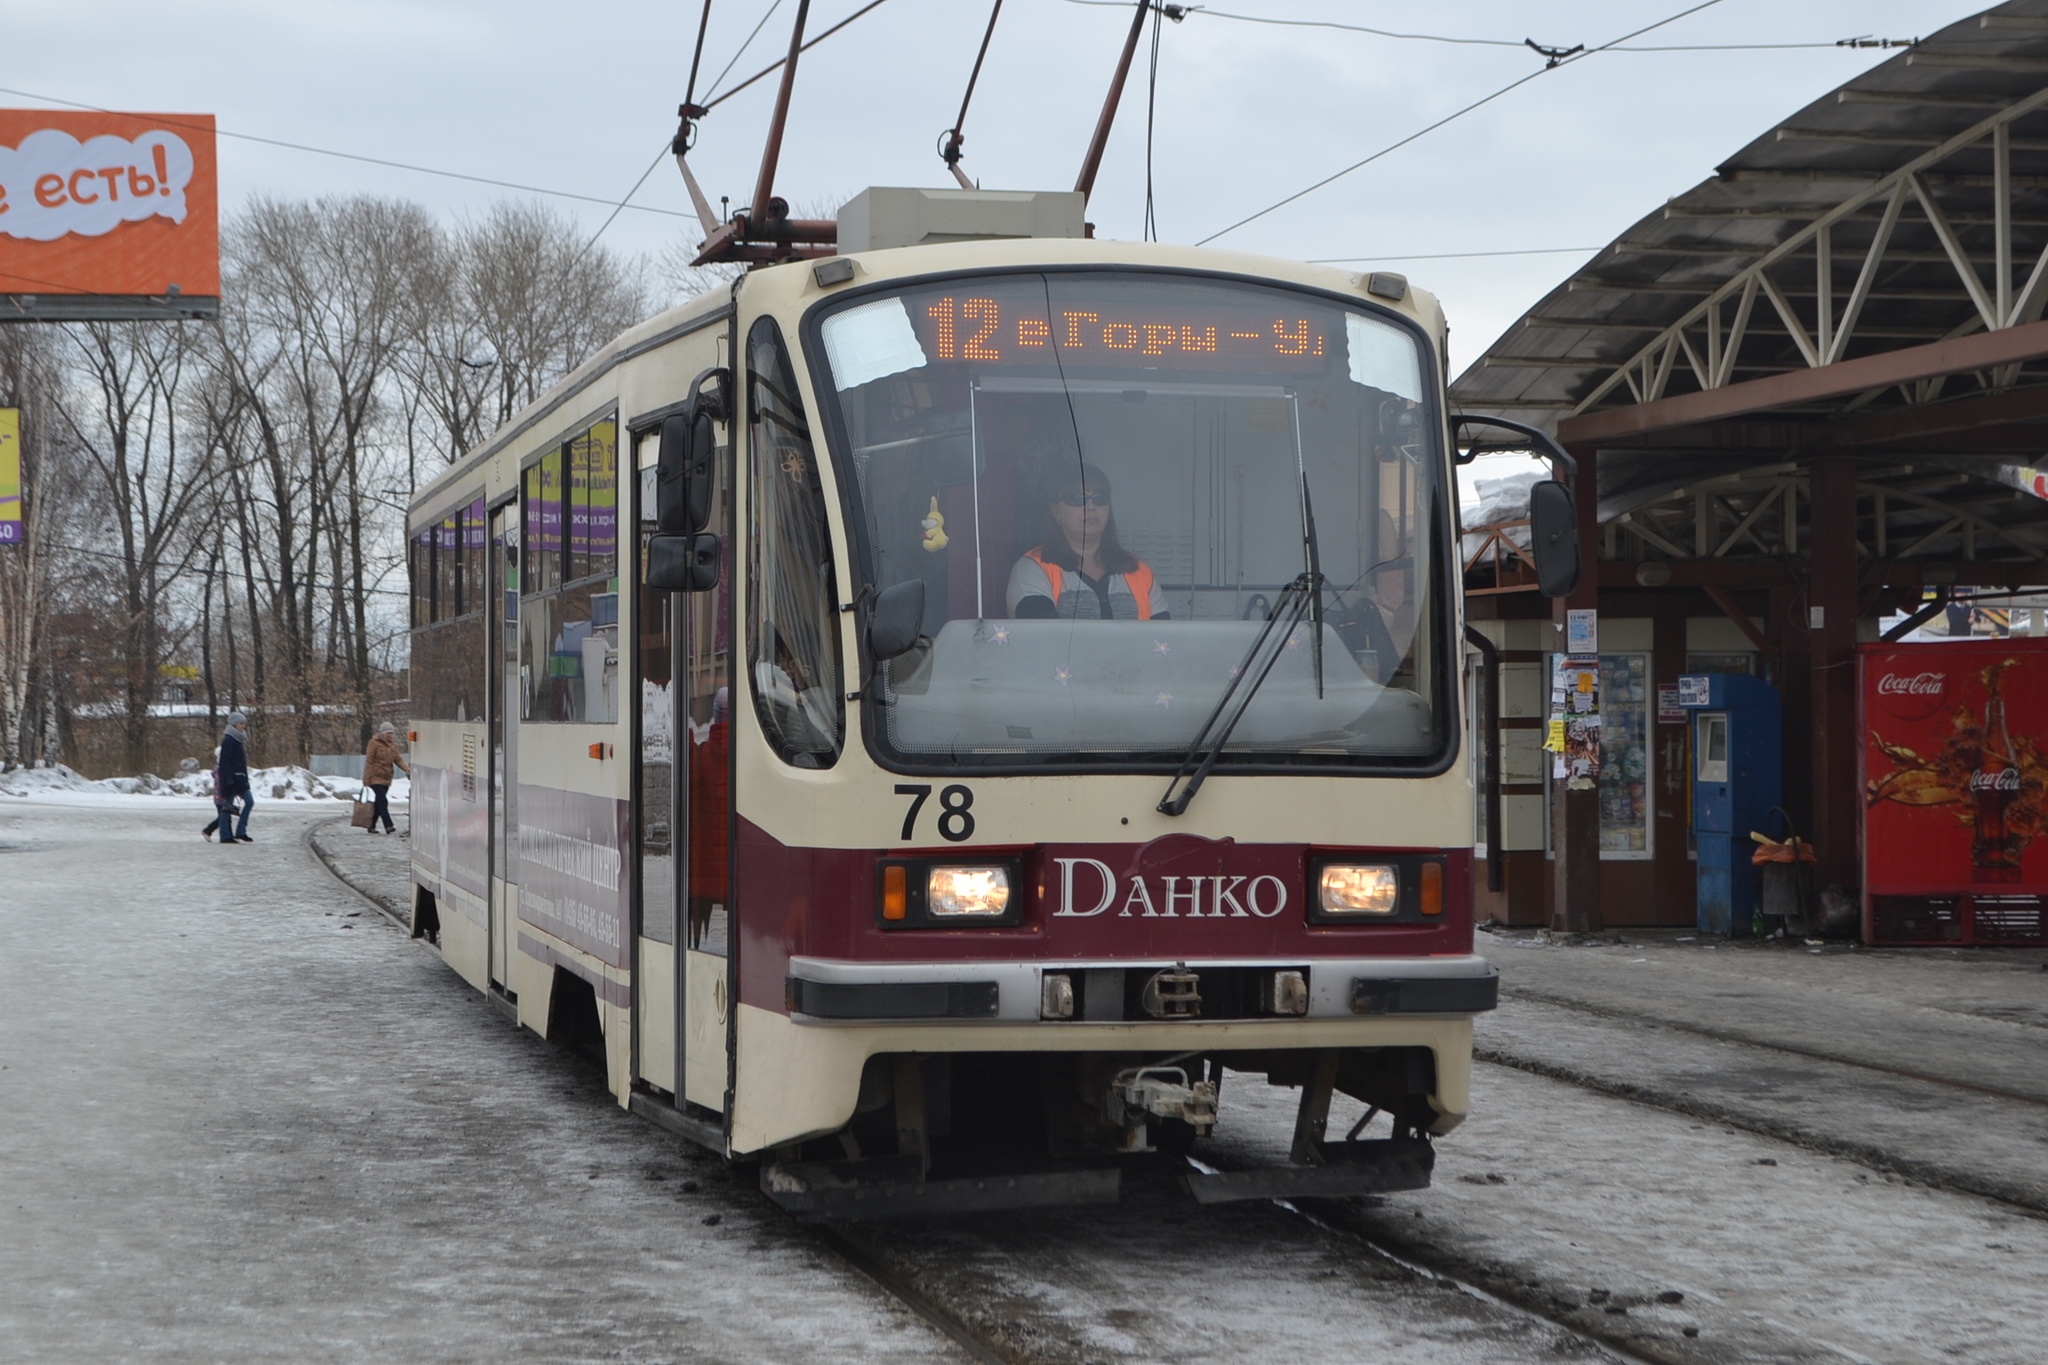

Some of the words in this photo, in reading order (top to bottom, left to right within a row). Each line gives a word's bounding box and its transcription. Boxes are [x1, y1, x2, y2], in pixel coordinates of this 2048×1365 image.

[34, 143, 171, 209] есть!
[928, 297, 999, 359] 12
[1063, 311, 1217, 355] Горы
[520, 665, 530, 719] 78
[1878, 673, 1945, 695] Coca-Cola
[894, 784, 976, 842] 78
[592, 843, 622, 894] ЦЕНТР
